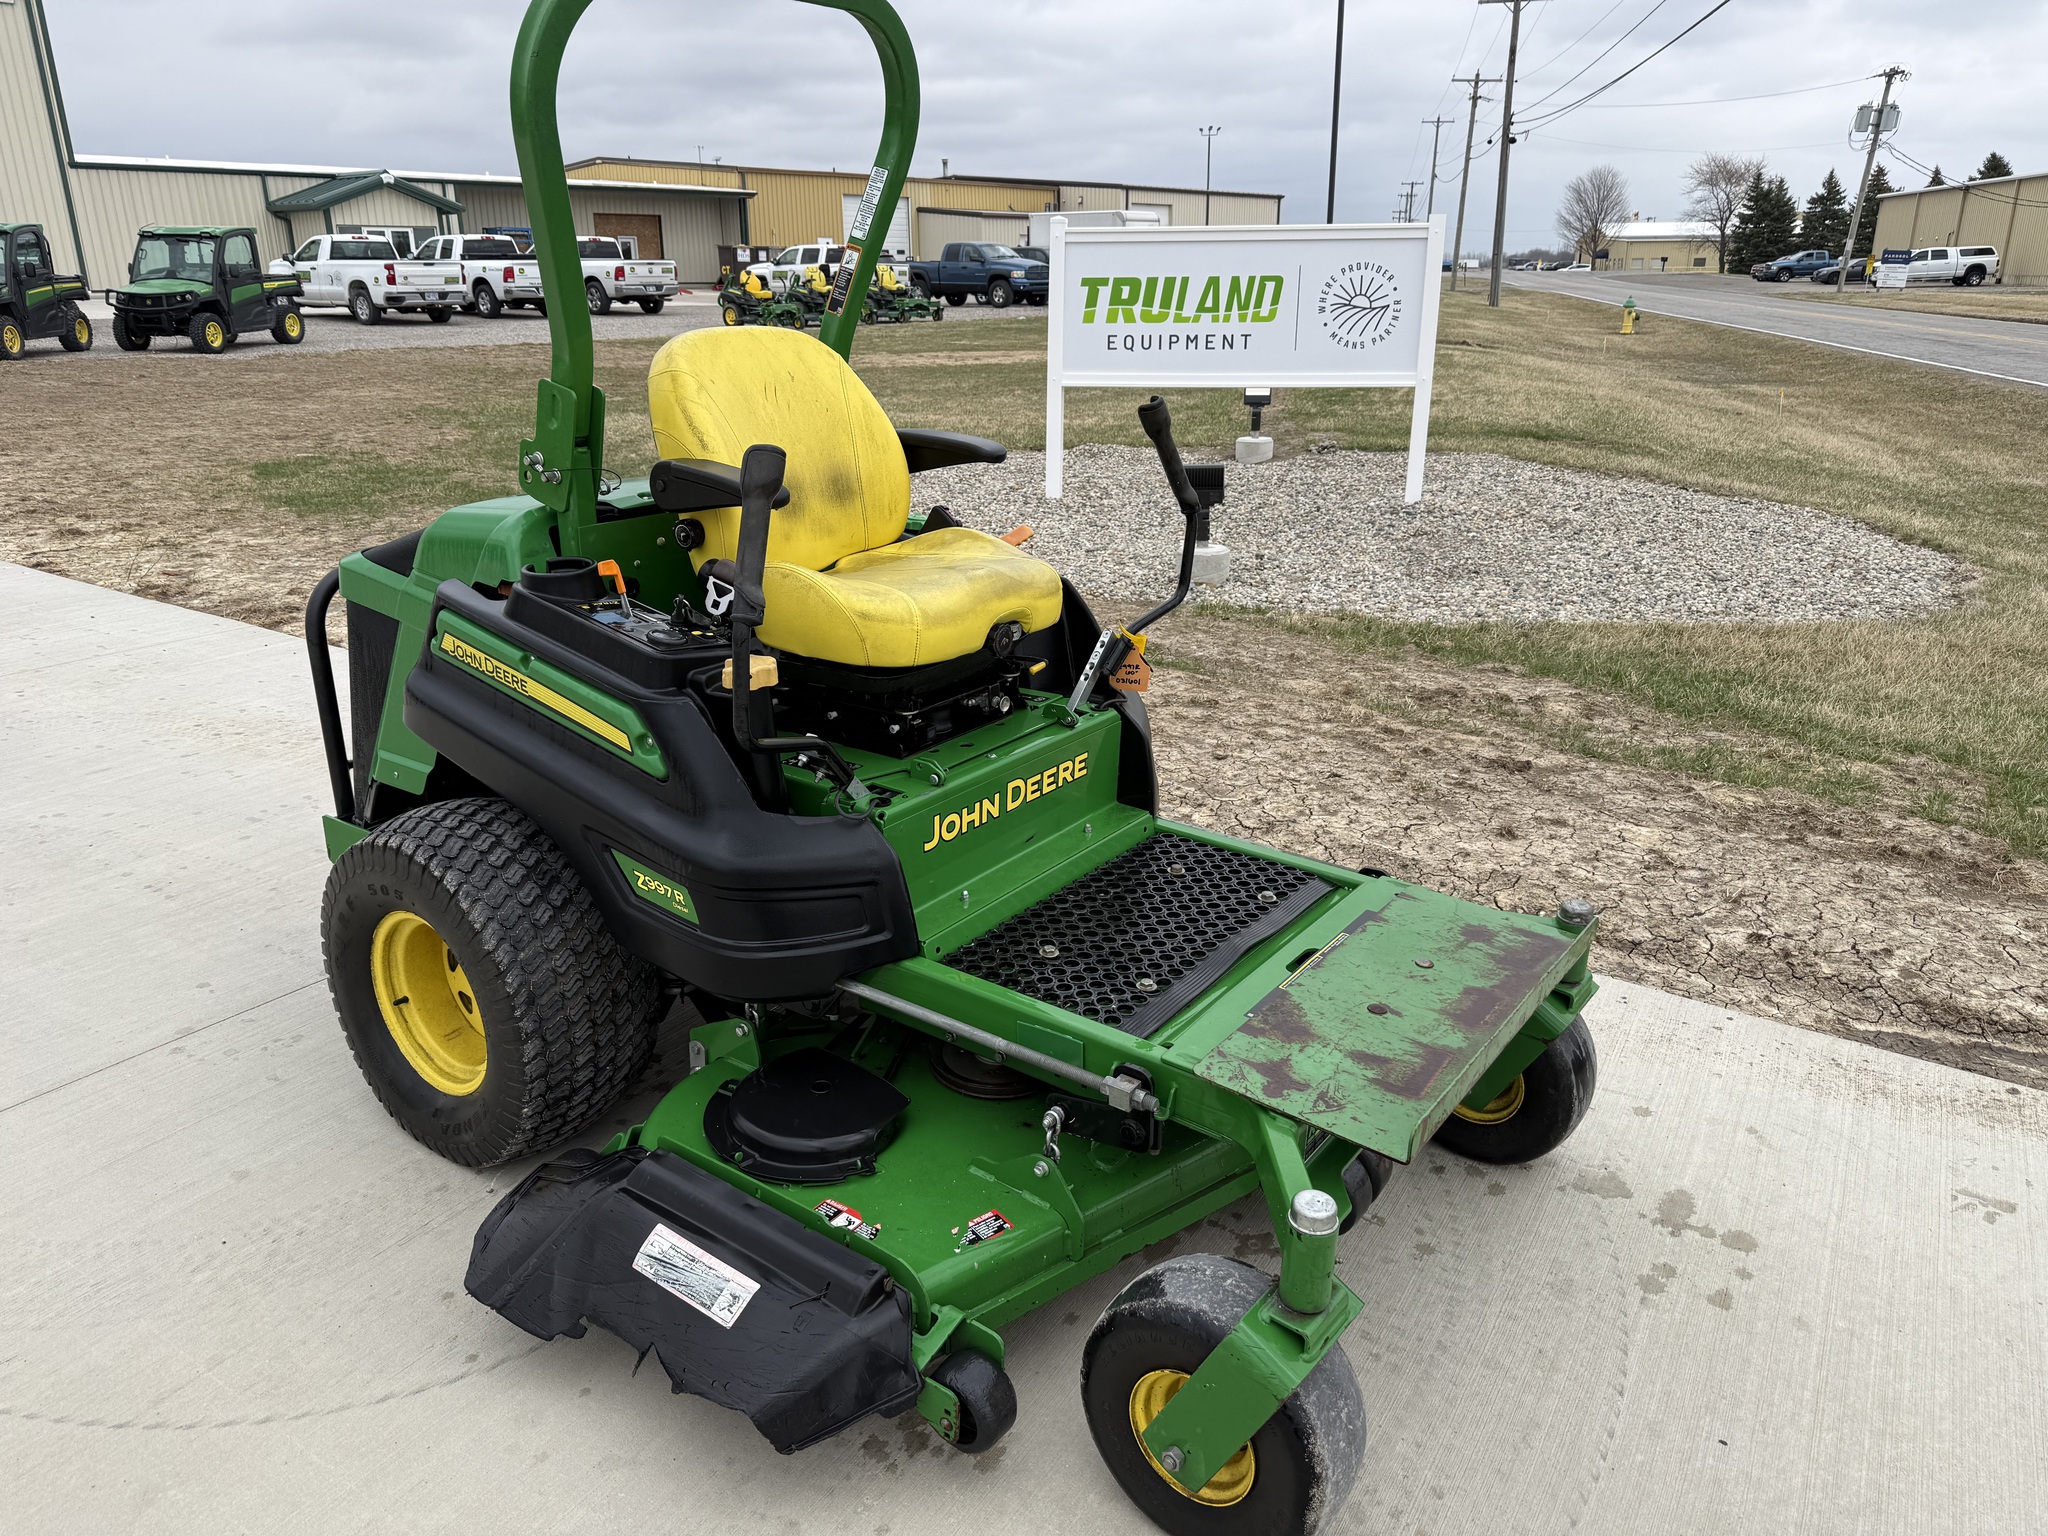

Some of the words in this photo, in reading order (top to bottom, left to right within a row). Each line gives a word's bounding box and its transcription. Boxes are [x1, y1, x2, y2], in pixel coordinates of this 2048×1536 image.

[1080, 275, 1284, 324] TRULAND
[1317, 275, 1338, 315] WHERE
[1340, 262, 1395, 283] PROVIDER
[1107, 333, 1252, 352] EQUIPMENT
[1329, 331, 1365, 350] MEANS
[1371, 299, 1402, 346] PARTNER
[449, 639, 483, 672] JOHN
[484, 656, 529, 696] DEERE
[923, 791, 1000, 853] JOHN
[1005, 751, 1089, 813] DEERE
[633, 869, 686, 906] Z997R
